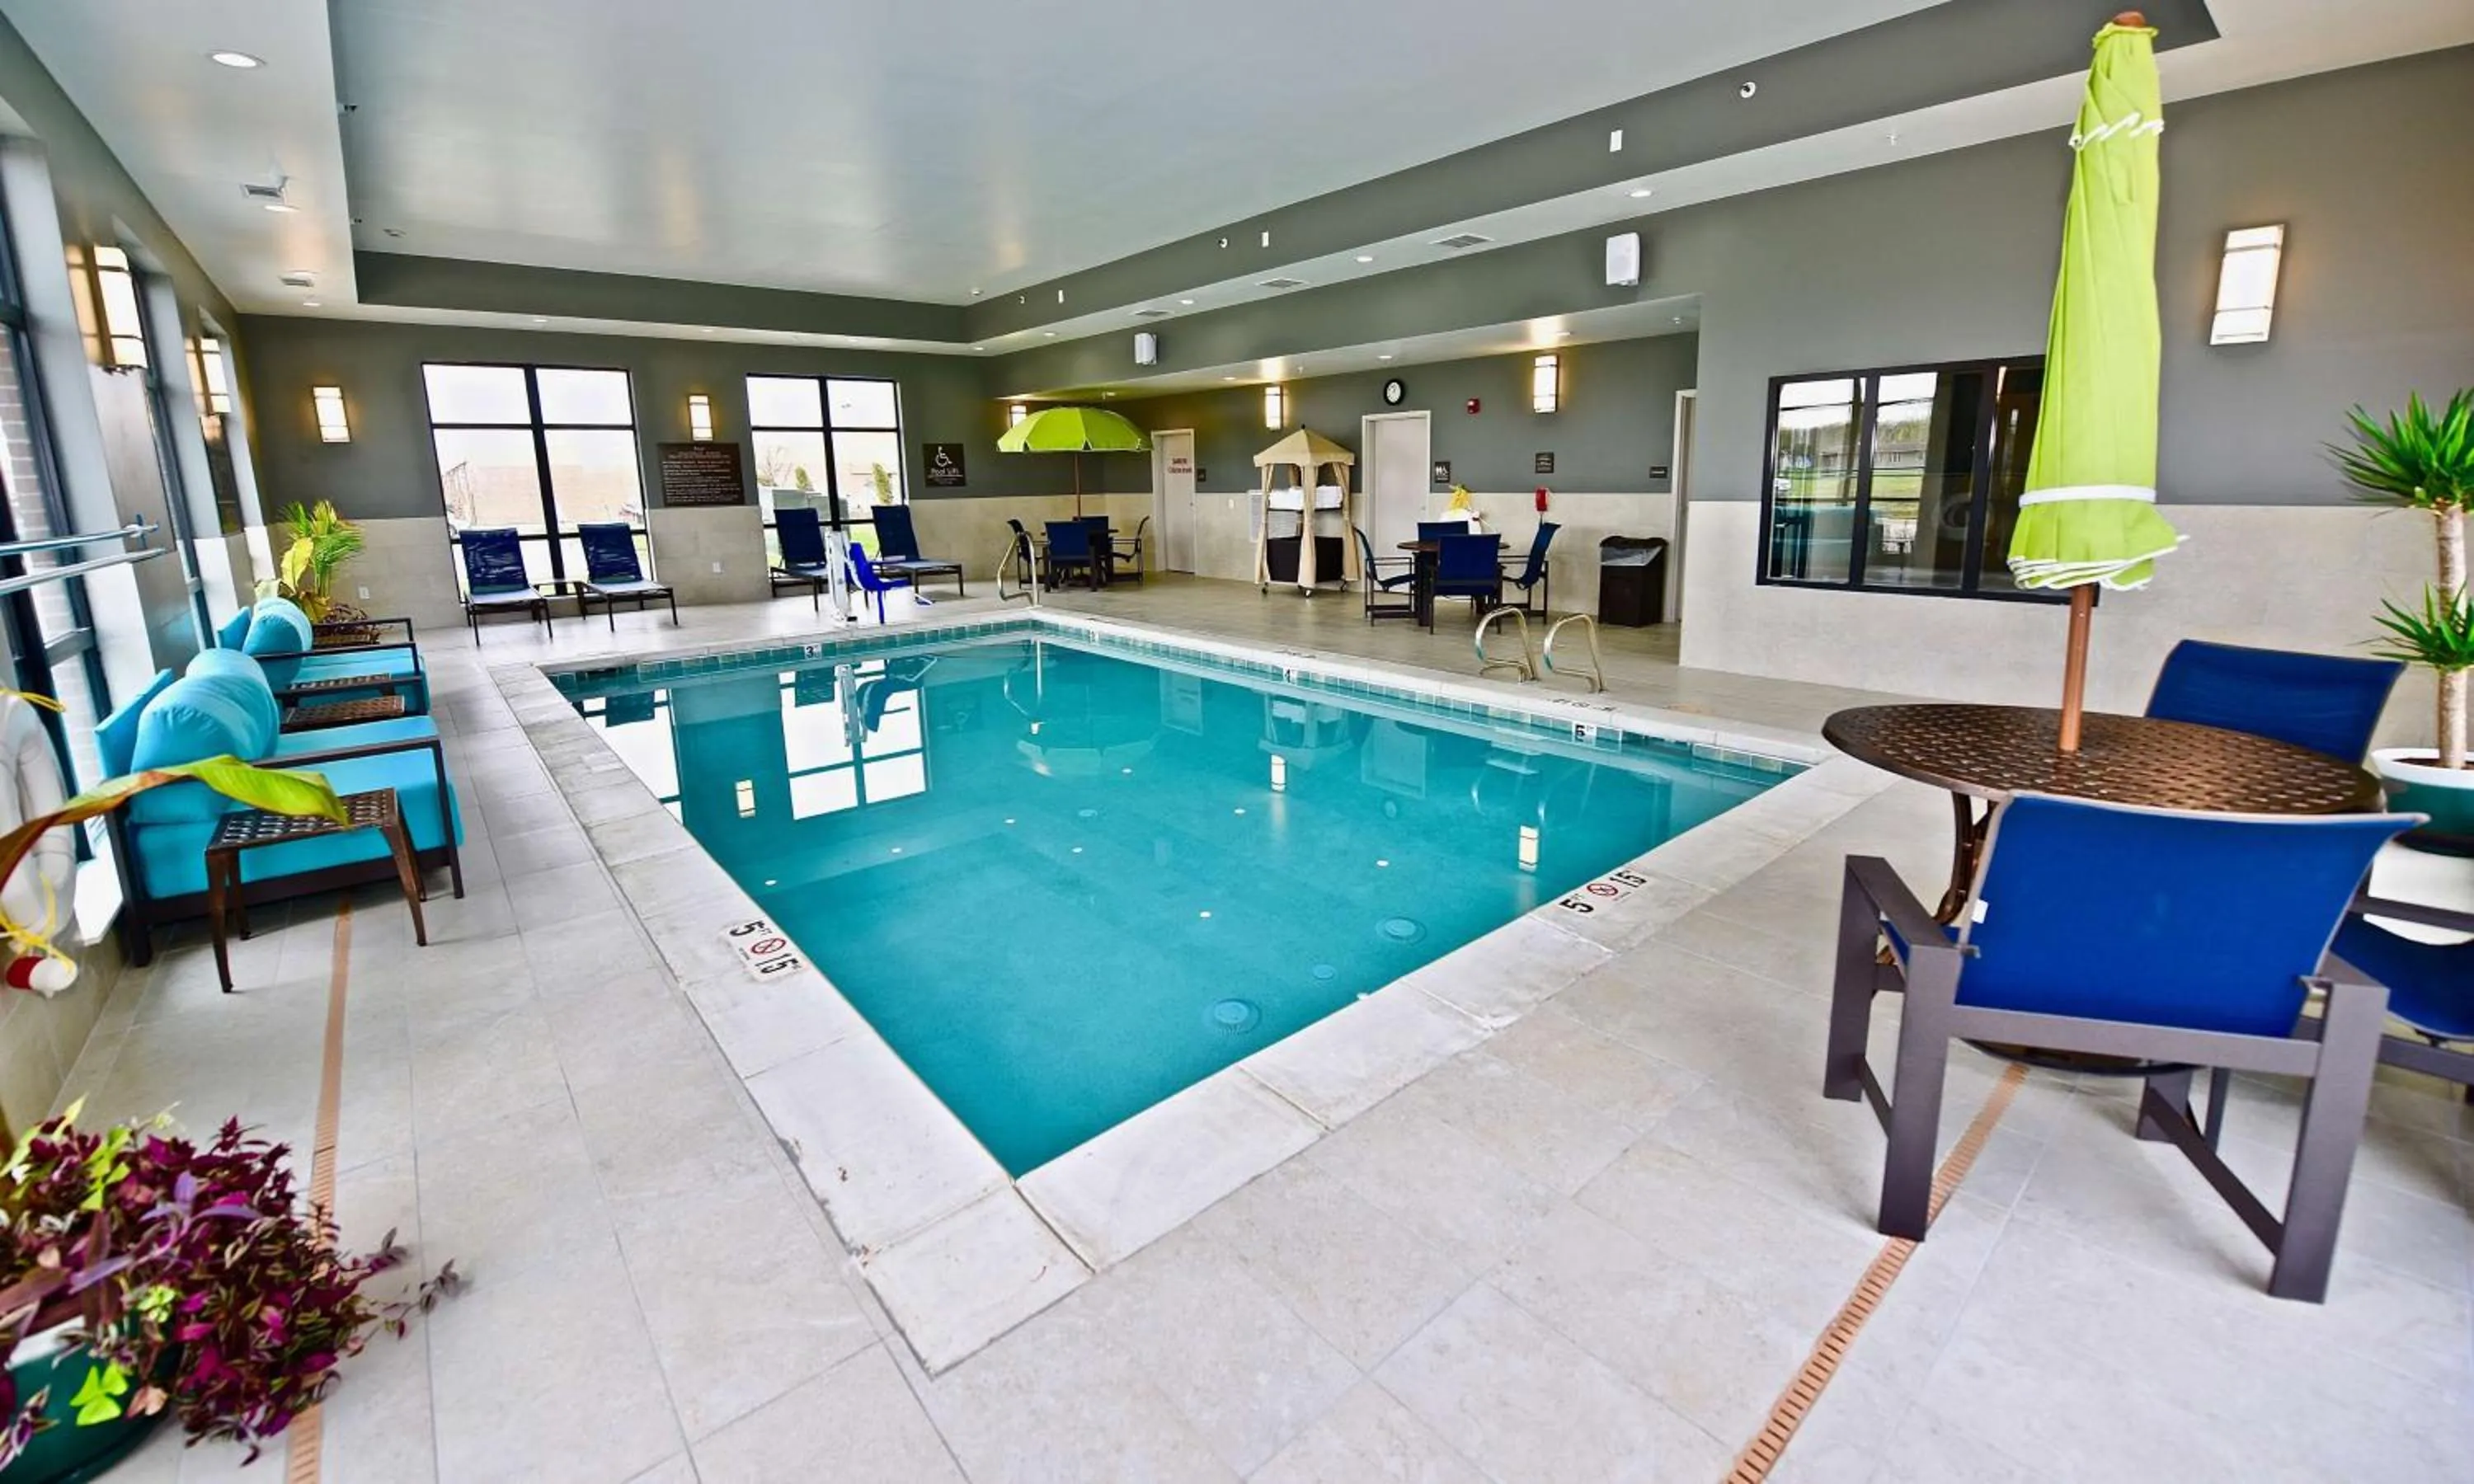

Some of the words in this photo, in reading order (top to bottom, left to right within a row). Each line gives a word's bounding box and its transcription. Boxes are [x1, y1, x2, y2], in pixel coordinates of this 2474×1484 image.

[806, 646, 814, 659] 3
[1559, 898, 1594, 913] 5
[729, 919, 765, 937] 5
